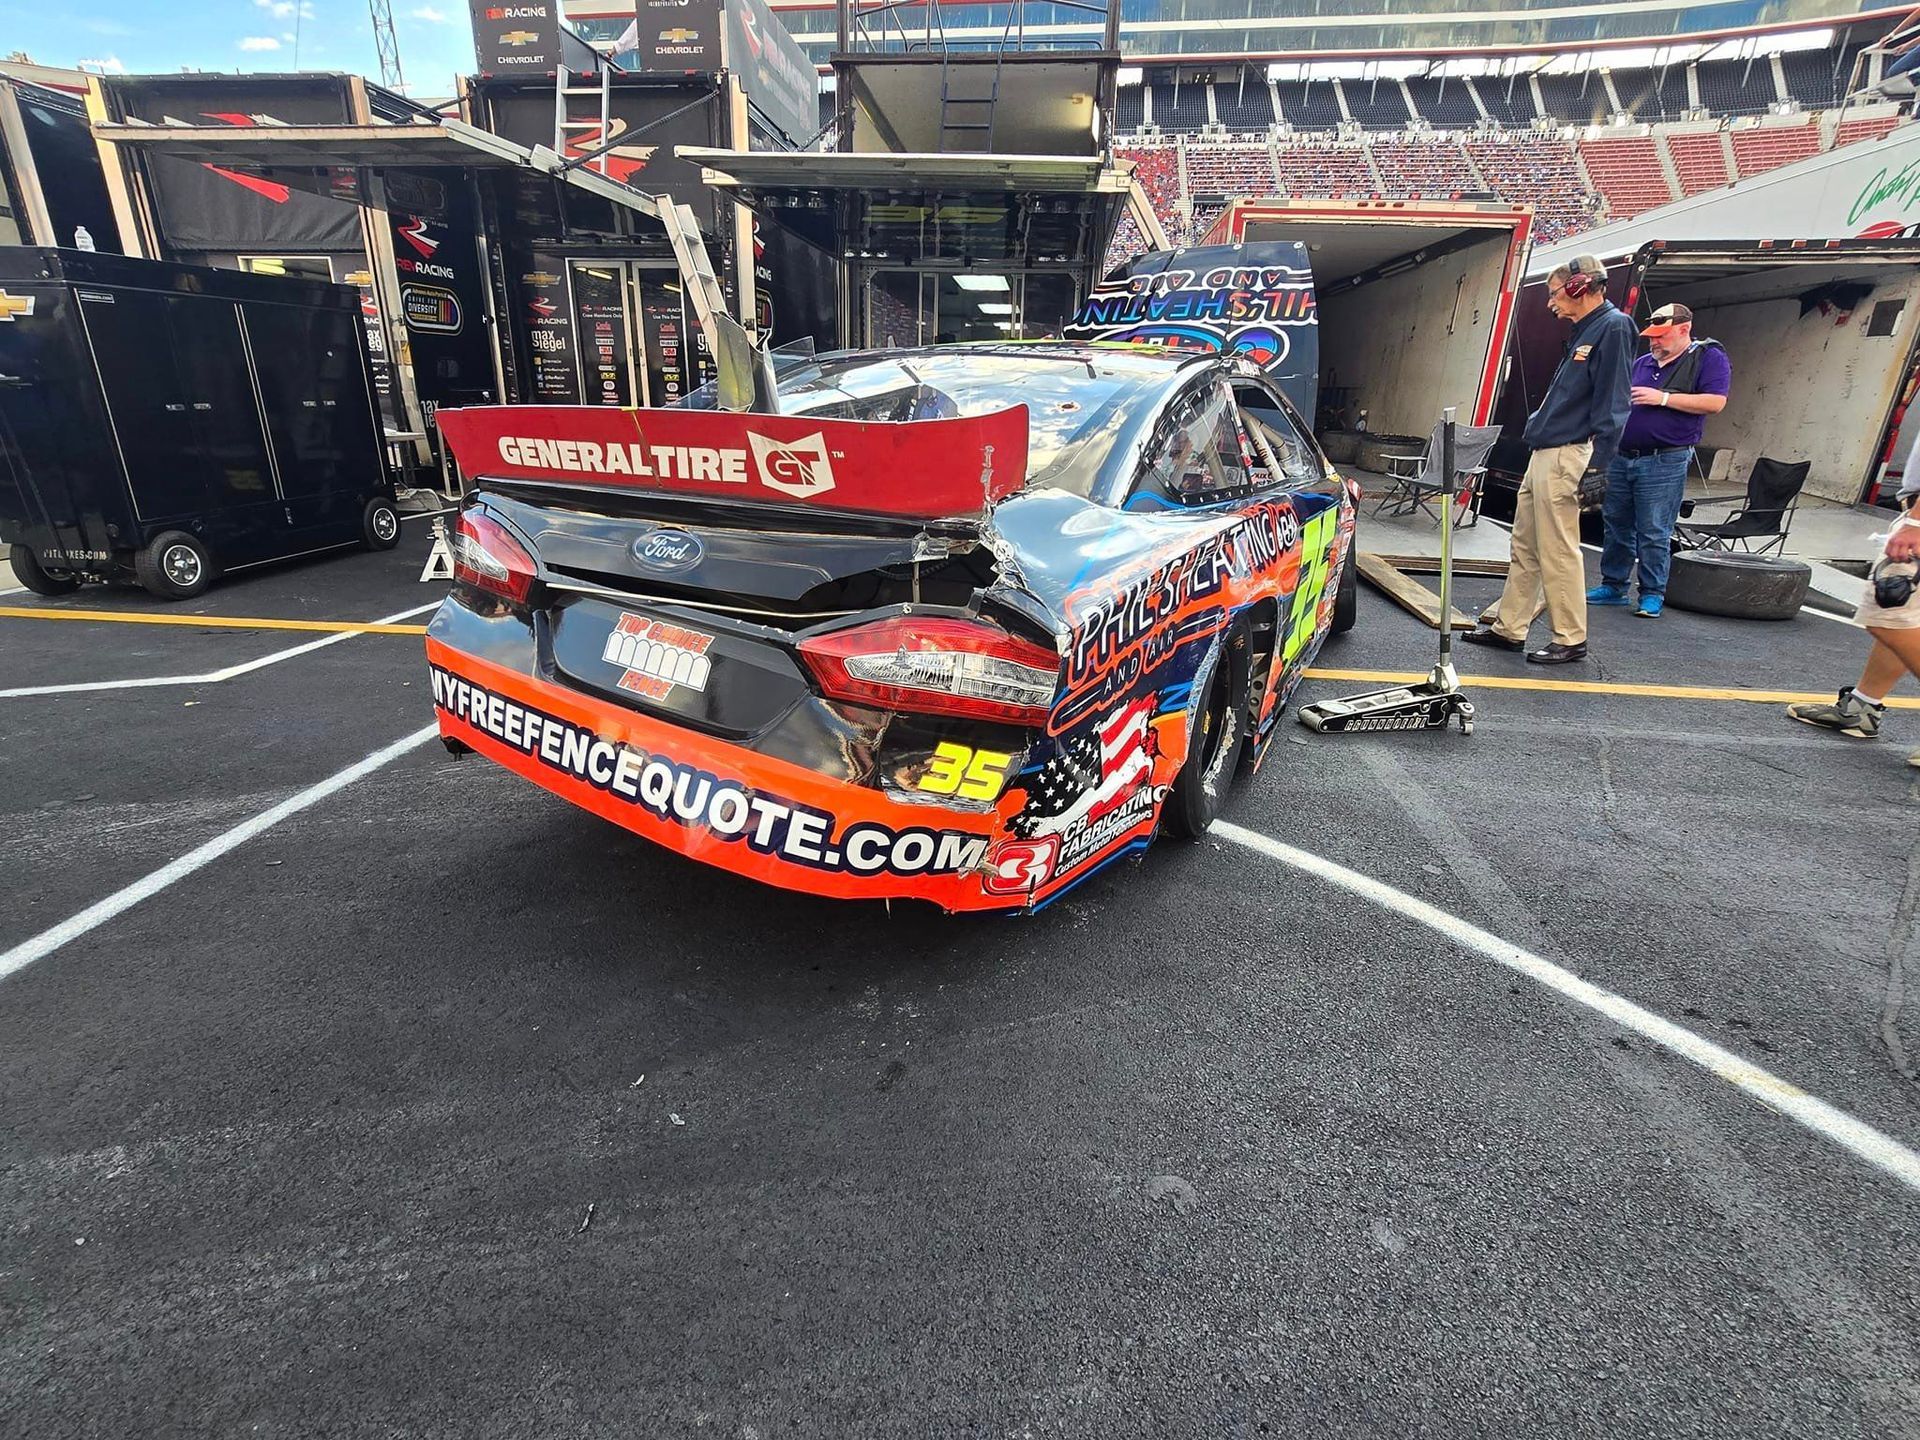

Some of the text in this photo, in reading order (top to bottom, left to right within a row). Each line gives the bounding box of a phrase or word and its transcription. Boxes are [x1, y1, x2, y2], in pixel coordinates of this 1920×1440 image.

[505, 7, 547, 18] RACING
[497, 55, 545, 64] CHEVROLET
[655, 46, 704, 54] CHEVROLET
[415, 261, 455, 279] RACING
[755, 265, 772, 281] ACING
[1212, 271, 1281, 286] AND
[407, 302, 438, 314] DIVERSITY
[1075, 290, 1318, 324] HEATIN HIL'S
[537, 317, 568, 325] RACING
[531, 330, 555, 340] max
[645, 534, 691, 561] Ford
[617, 612, 713, 654] TOP CHOICE
[1104, 629, 1175, 695] AND AIR
[619, 671, 672, 699] FENCE
[429, 666, 987, 870] MYFREEFENCEQUOTE.COM
[918, 741, 1011, 801] 35
[1063, 815, 1089, 842] CB
[1054, 850, 1088, 877] Custom
